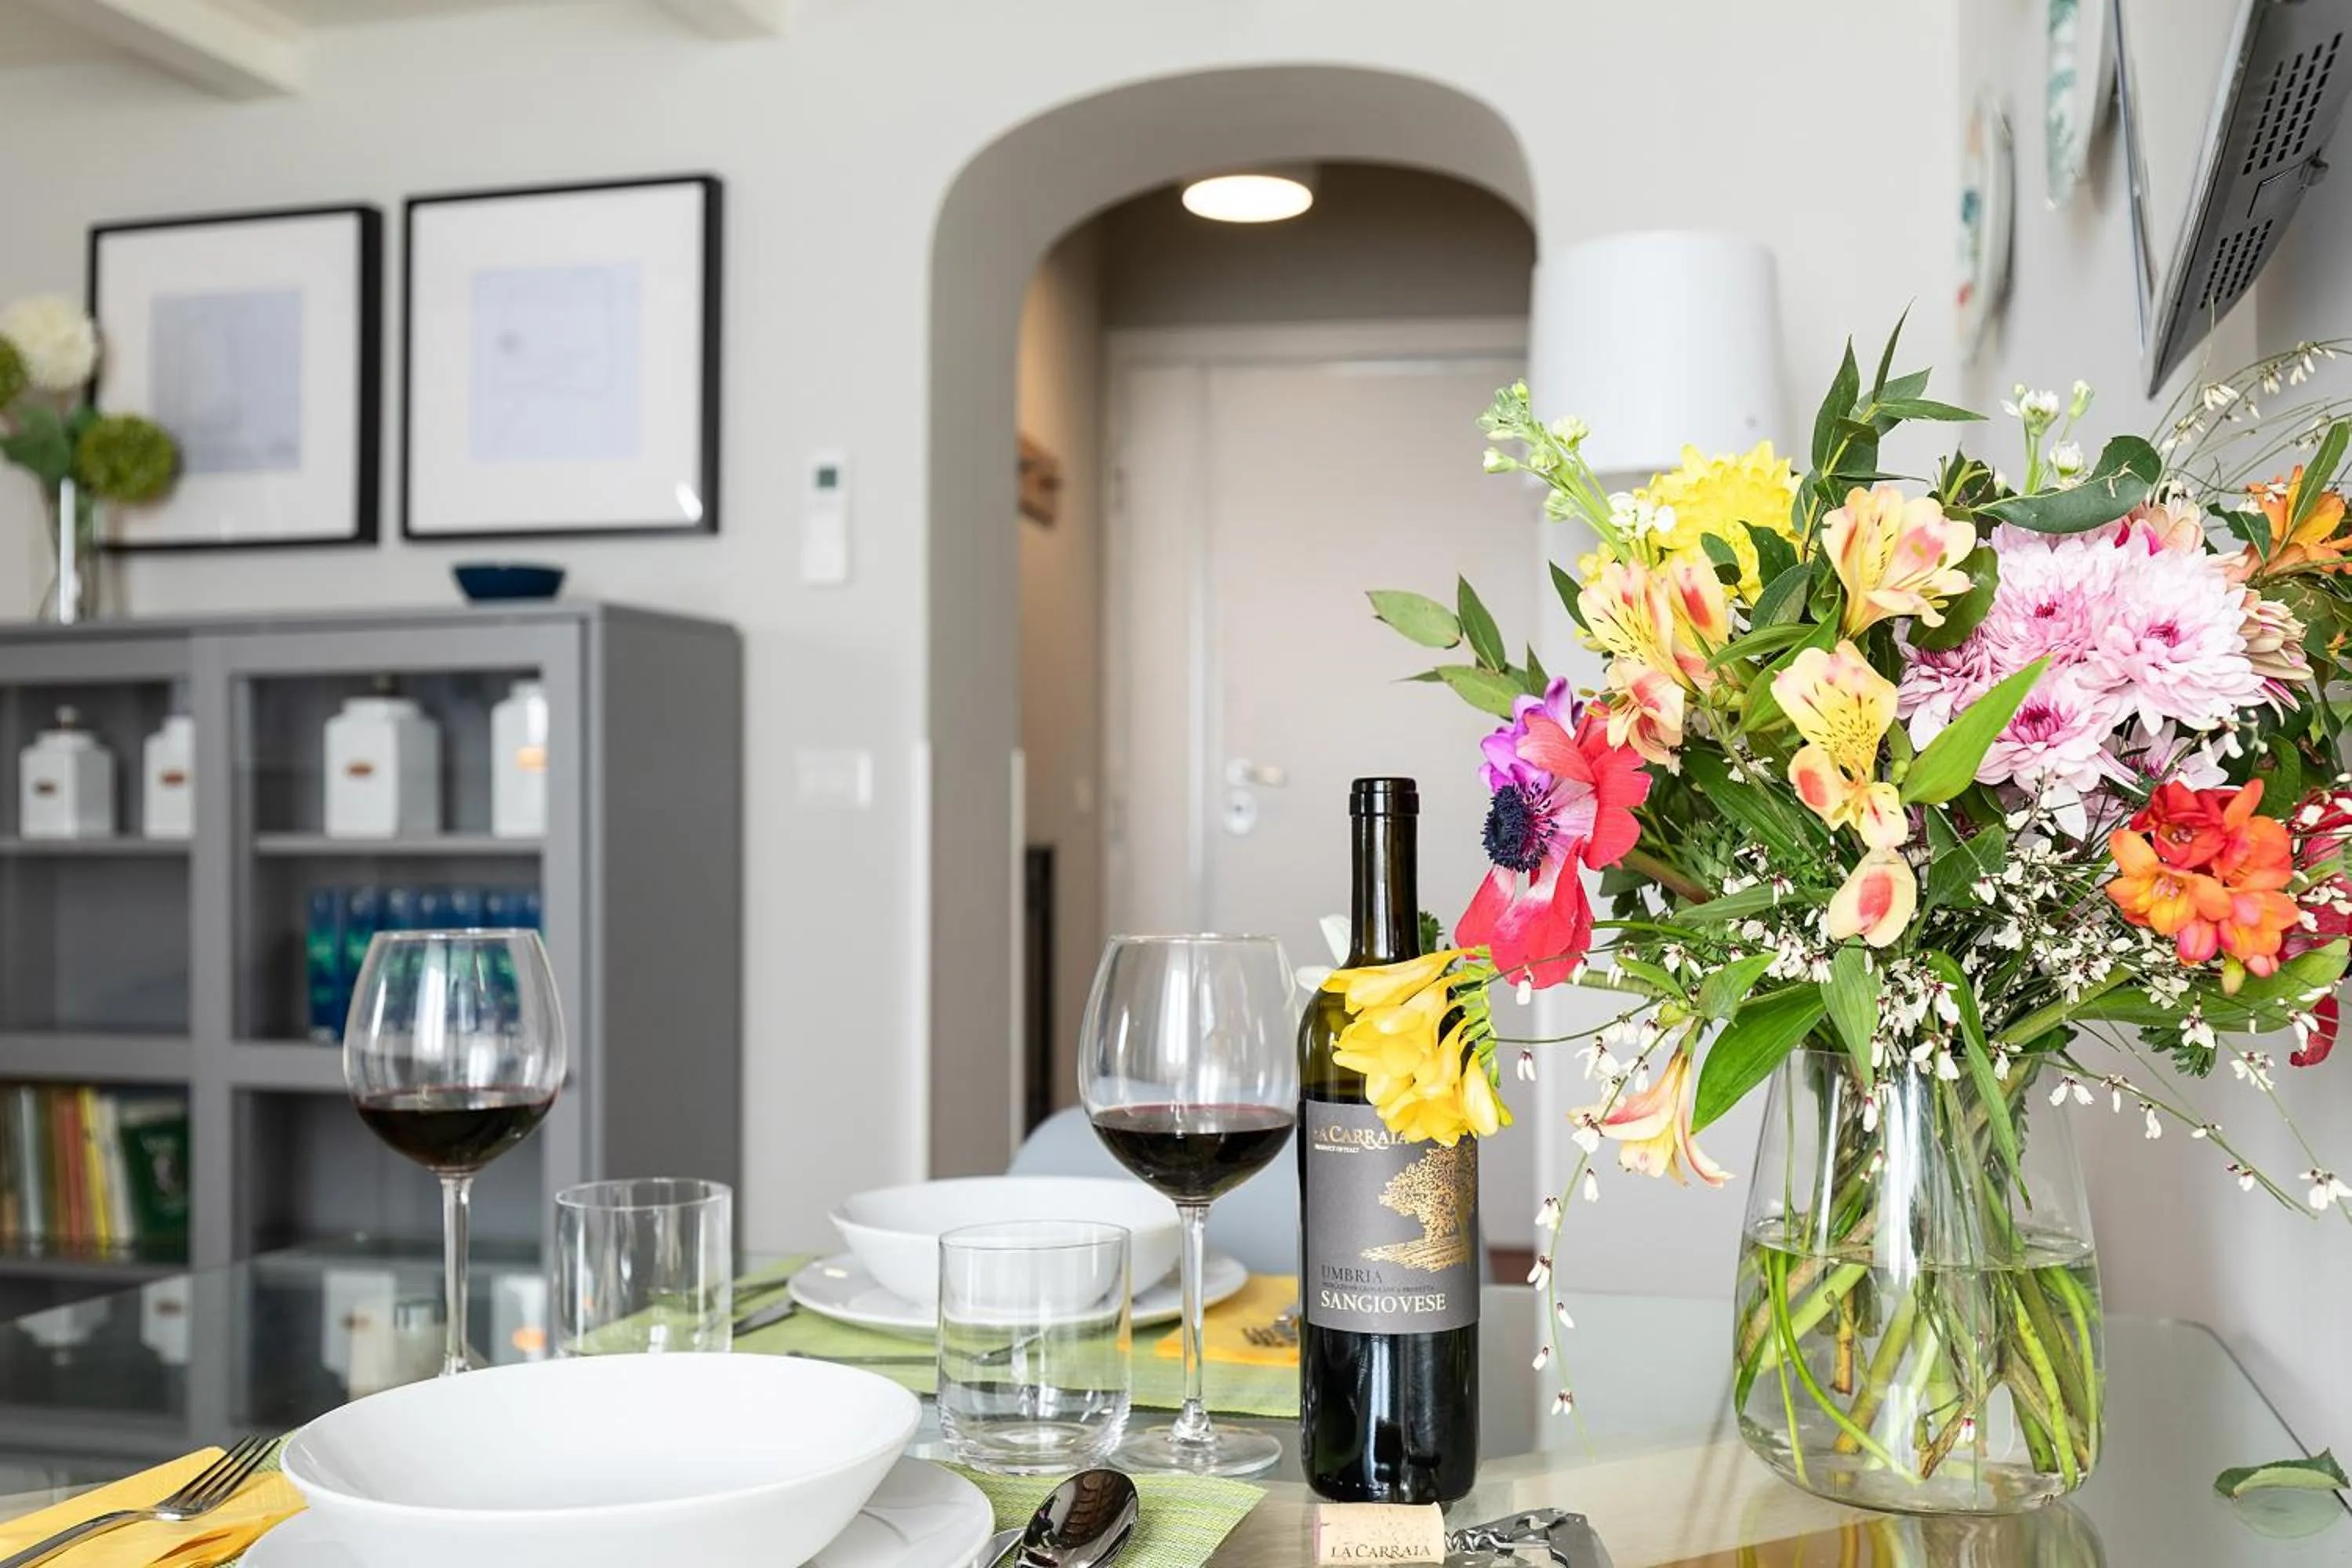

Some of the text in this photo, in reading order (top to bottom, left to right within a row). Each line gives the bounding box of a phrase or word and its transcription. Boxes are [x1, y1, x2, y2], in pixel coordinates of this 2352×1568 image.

[1321, 1265, 1382, 1283] UMBRIA
[1321, 1290, 1446, 1313] SANGIOVESE
[1330, 1544, 1431, 1559] LA CARRAIA
